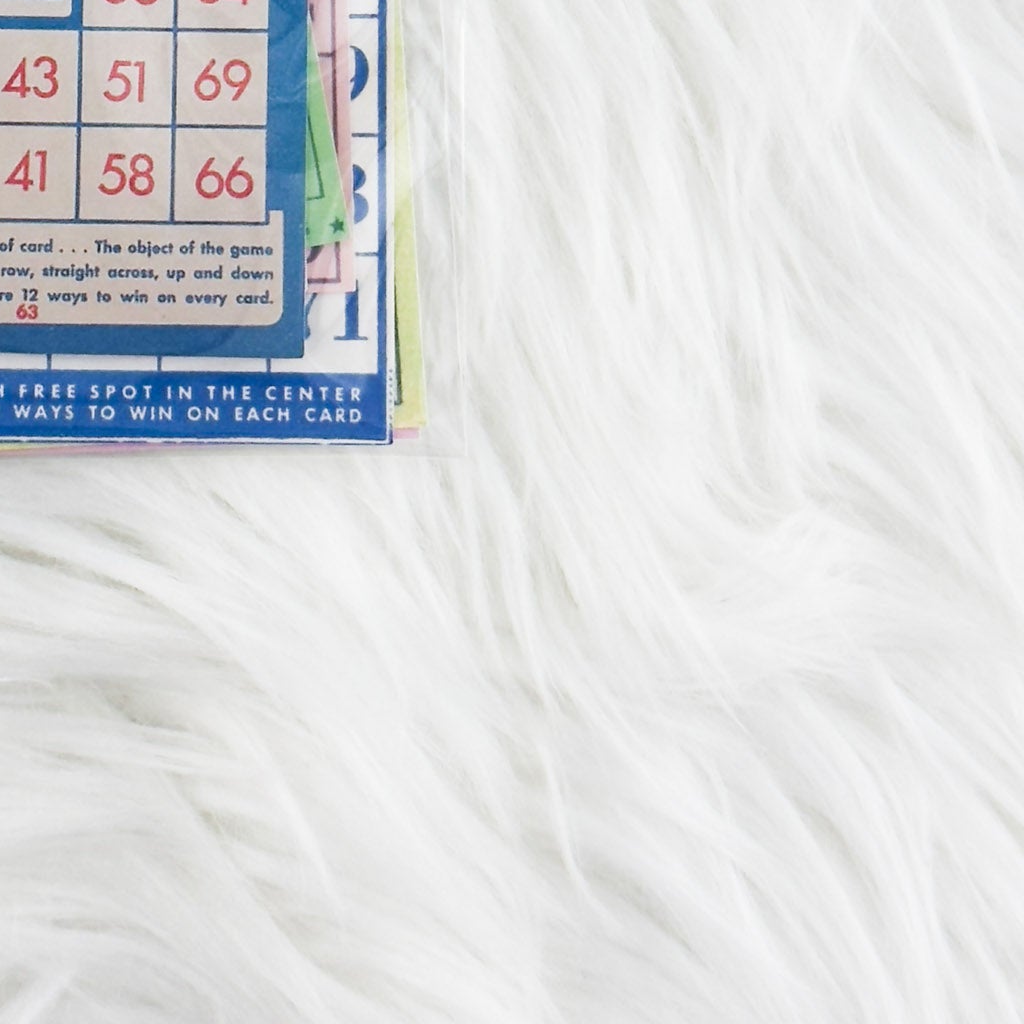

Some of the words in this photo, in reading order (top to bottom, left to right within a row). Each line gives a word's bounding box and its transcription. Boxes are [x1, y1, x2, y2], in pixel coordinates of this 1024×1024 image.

[1, 56, 59, 100] 43
[103, 60, 145, 103] 51
[193, 59, 252, 103] 69
[4, 149, 47, 192] 41
[97, 153, 155, 197] 58
[195, 157, 254, 200] 66
[19, 238, 54, 253] card
[94, 239, 122, 253] The
[127, 239, 174, 257] object
[179, 240, 196, 255] of
[200, 240, 225, 255] the
[229, 244, 274, 259] game
[0, 266, 35, 279] row,
[42, 262, 101, 282] straight
[107, 268, 160, 281] across,
[166, 269, 186, 283] up
[193, 264, 224, 280] and
[230, 266, 274, 280] down
[16, 303, 39, 320] 63
[21, 287, 39, 302] 12
[46, 292, 88, 305] ways
[96, 290, 112, 303] to
[119, 289, 149, 303] win
[157, 293, 177, 304] on
[185, 294, 228, 308] every
[235, 289, 274, 305] card.
[19, 383, 76, 399] FREE
[90, 384, 153, 400] SPOT
[167, 385, 192, 401] IN
[207, 385, 252, 401] THE
[265, 385, 361, 402] CENTER
[13, 404, 75, 420] WAYS
[88, 405, 116, 421] TO
[129, 406, 173, 421] WIN
[187, 406, 220, 421] ON
[234, 406, 290, 422] EACH
[304, 407, 362, 424] CARD
